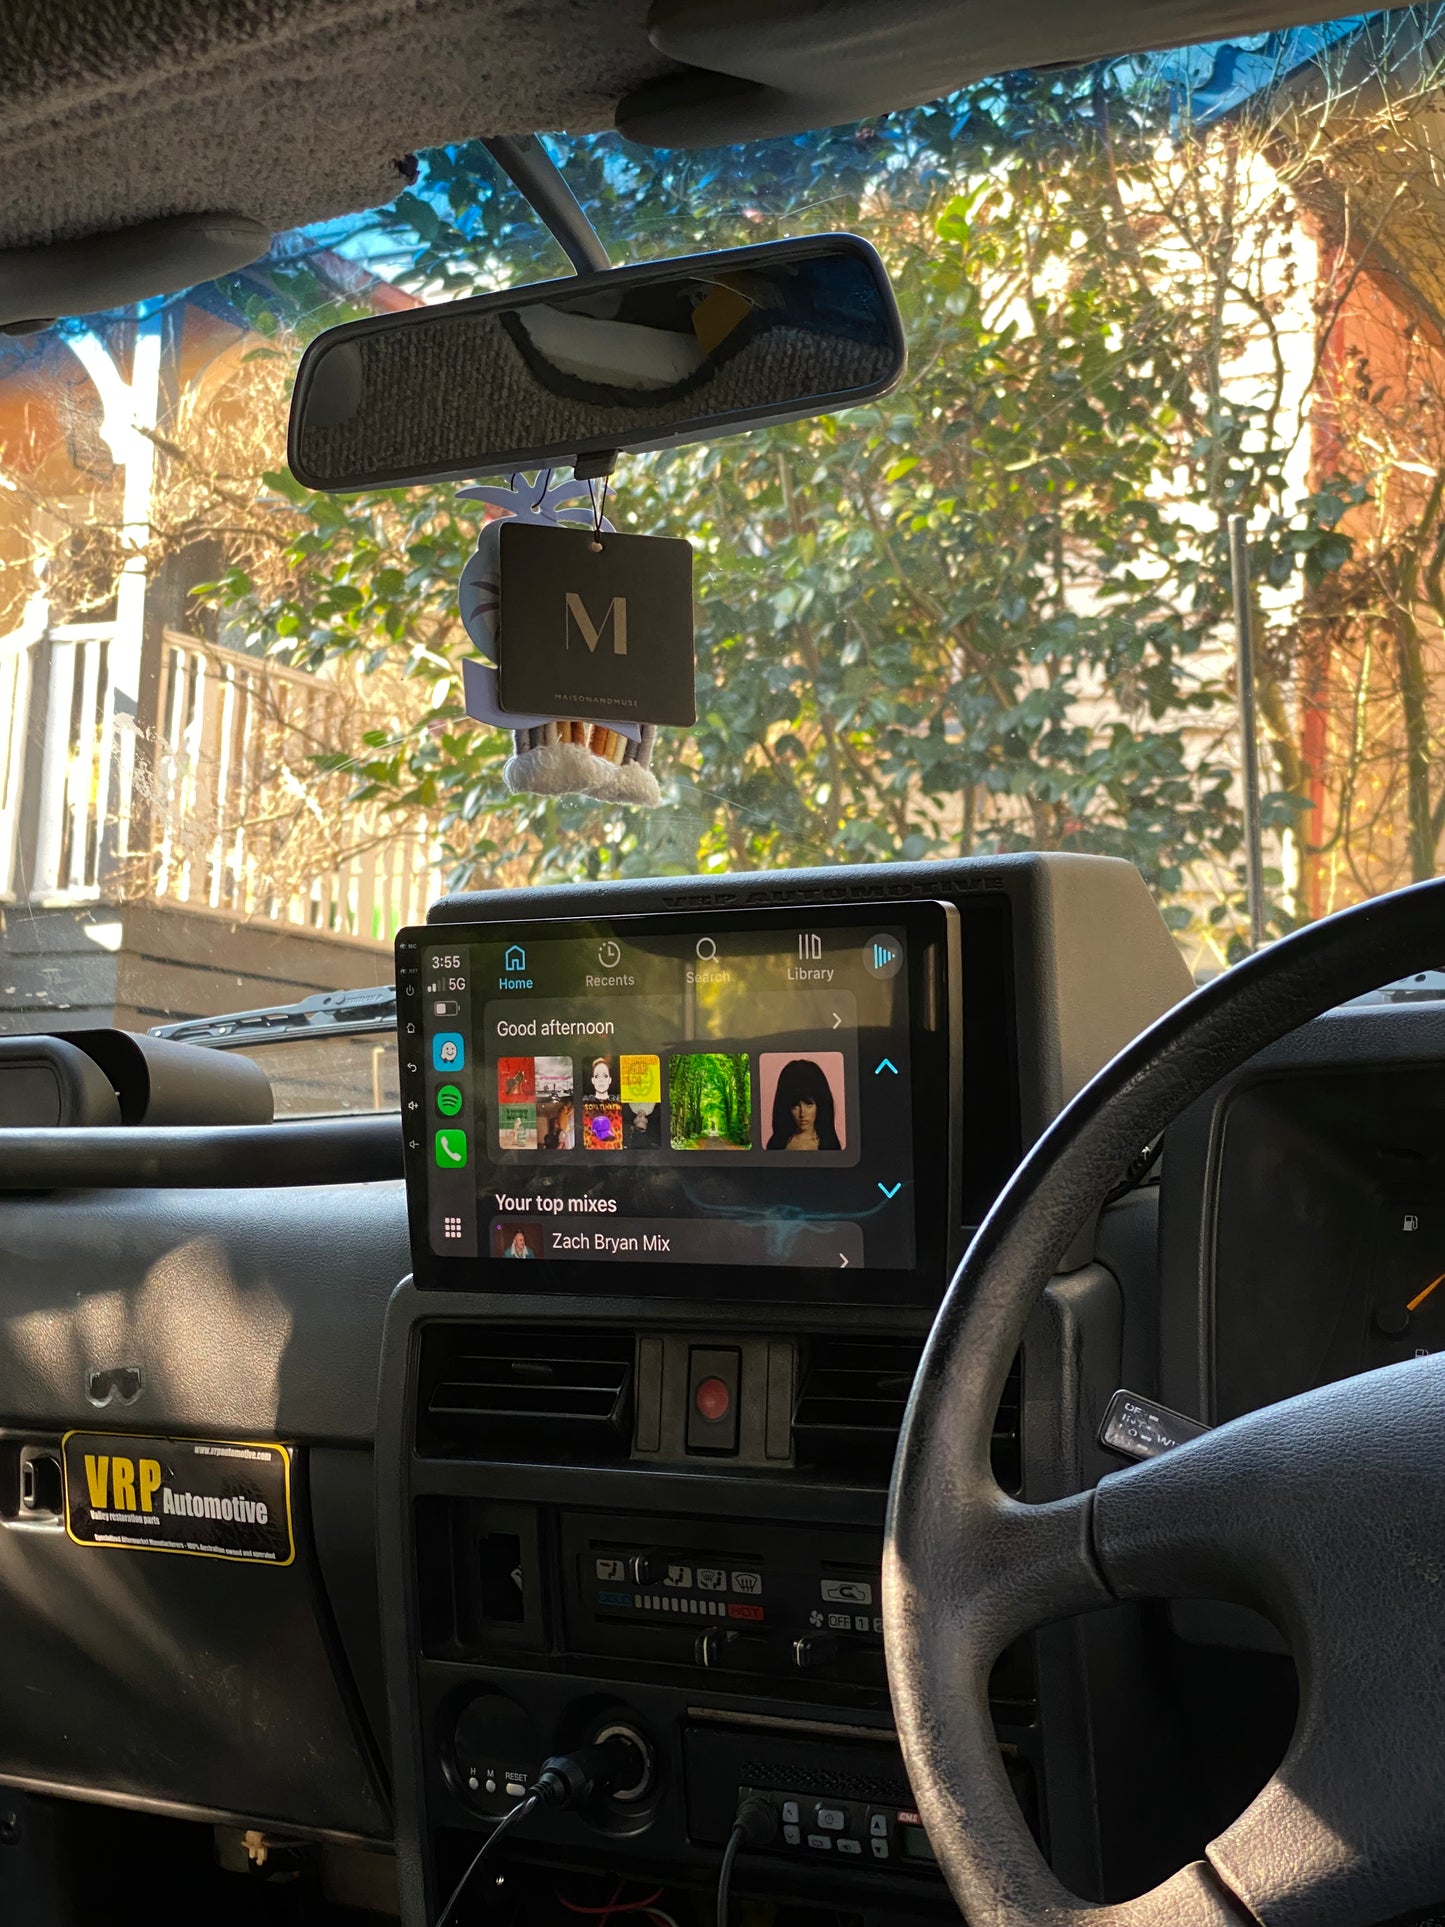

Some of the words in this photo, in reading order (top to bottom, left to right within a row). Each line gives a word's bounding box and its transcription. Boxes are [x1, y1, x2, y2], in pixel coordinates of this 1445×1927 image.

[565, 592, 628, 656] M
[432, 956, 460, 969] 3:55
[585, 974, 635, 988] Recents
[686, 970, 731, 984] Search
[787, 966, 834, 983] Library
[448, 977, 466, 991] 5G
[499, 977, 533, 990] Home
[496, 1019, 537, 1037] Good
[541, 1018, 615, 1036] afternoon
[495, 1194, 532, 1211] Your
[536, 1195, 564, 1215] top
[568, 1194, 617, 1213] mixes
[552, 1233, 590, 1249] Zach
[594, 1234, 639, 1254] Bryan
[643, 1234, 671, 1252] Mix
[84, 1454, 162, 1512] VRP
[163, 1487, 268, 1525] Automotive
[90, 1510, 109, 1522] Valley
[109, 1512, 144, 1524] restoration
[143, 1515, 160, 1525] parts
[830, 1615, 849, 1627] OFF
[470, 1767, 476, 1775] H
[487, 1769, 494, 1777] M
[505, 1771, 528, 1783] RESET
